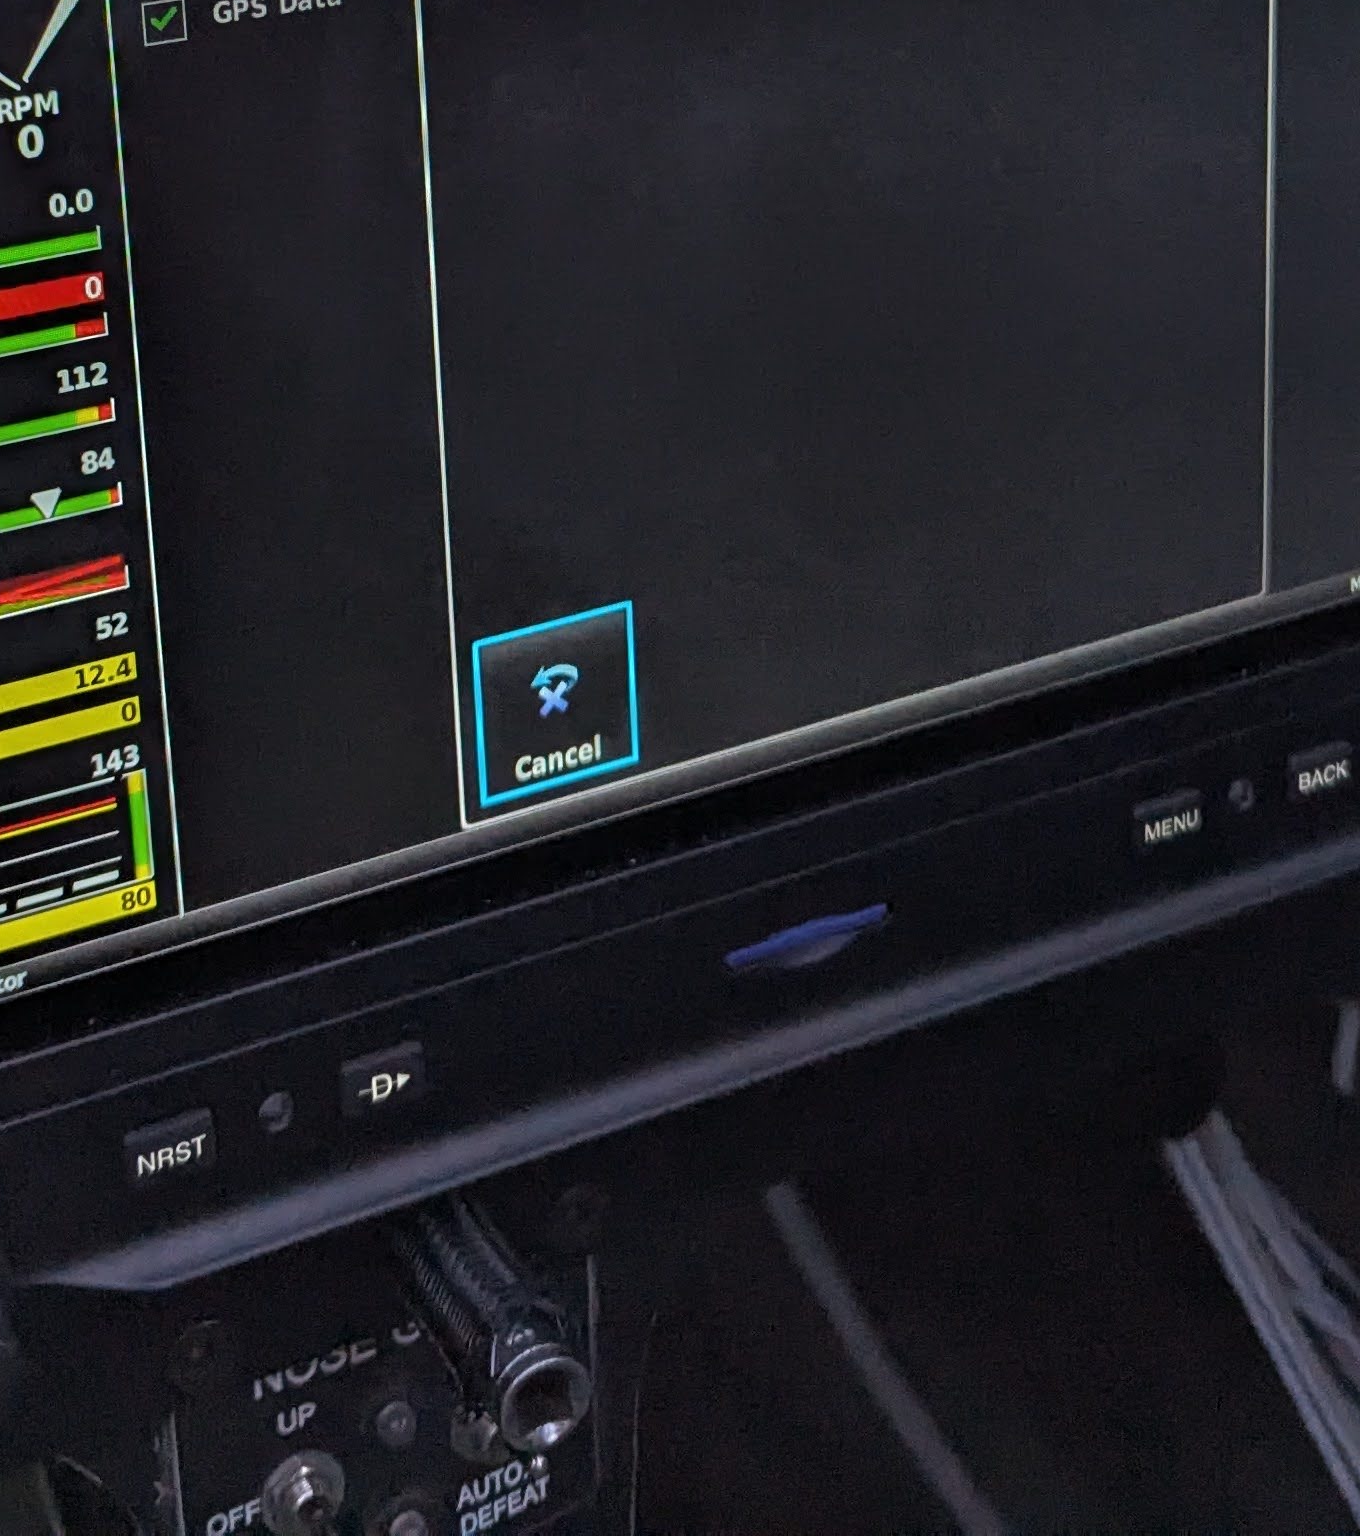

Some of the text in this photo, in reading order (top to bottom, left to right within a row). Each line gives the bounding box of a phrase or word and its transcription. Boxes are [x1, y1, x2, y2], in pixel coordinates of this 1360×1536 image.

[18, 124, 45, 159] 0
[48, 188, 94, 218] 0.0
[84, 276, 102, 300] 0
[56, 362, 109, 395] 112
[81, 446, 116, 476] 84
[95, 611, 130, 642] 52
[75, 658, 133, 691] 12.4
[120, 702, 138, 724] 0
[90, 744, 141, 780] 143
[515, 734, 602, 783] Cancel
[1298, 759, 1351, 794] BACK
[1143, 808, 1202, 844] MENU
[120, 886, 152, 913] 80
[136, 1133, 207, 1179] NRST
[277, 1402, 317, 1437] UP
[207, 1497, 263, 1536] OFF
[460, 1475, 552, 1536] DEFEAT
